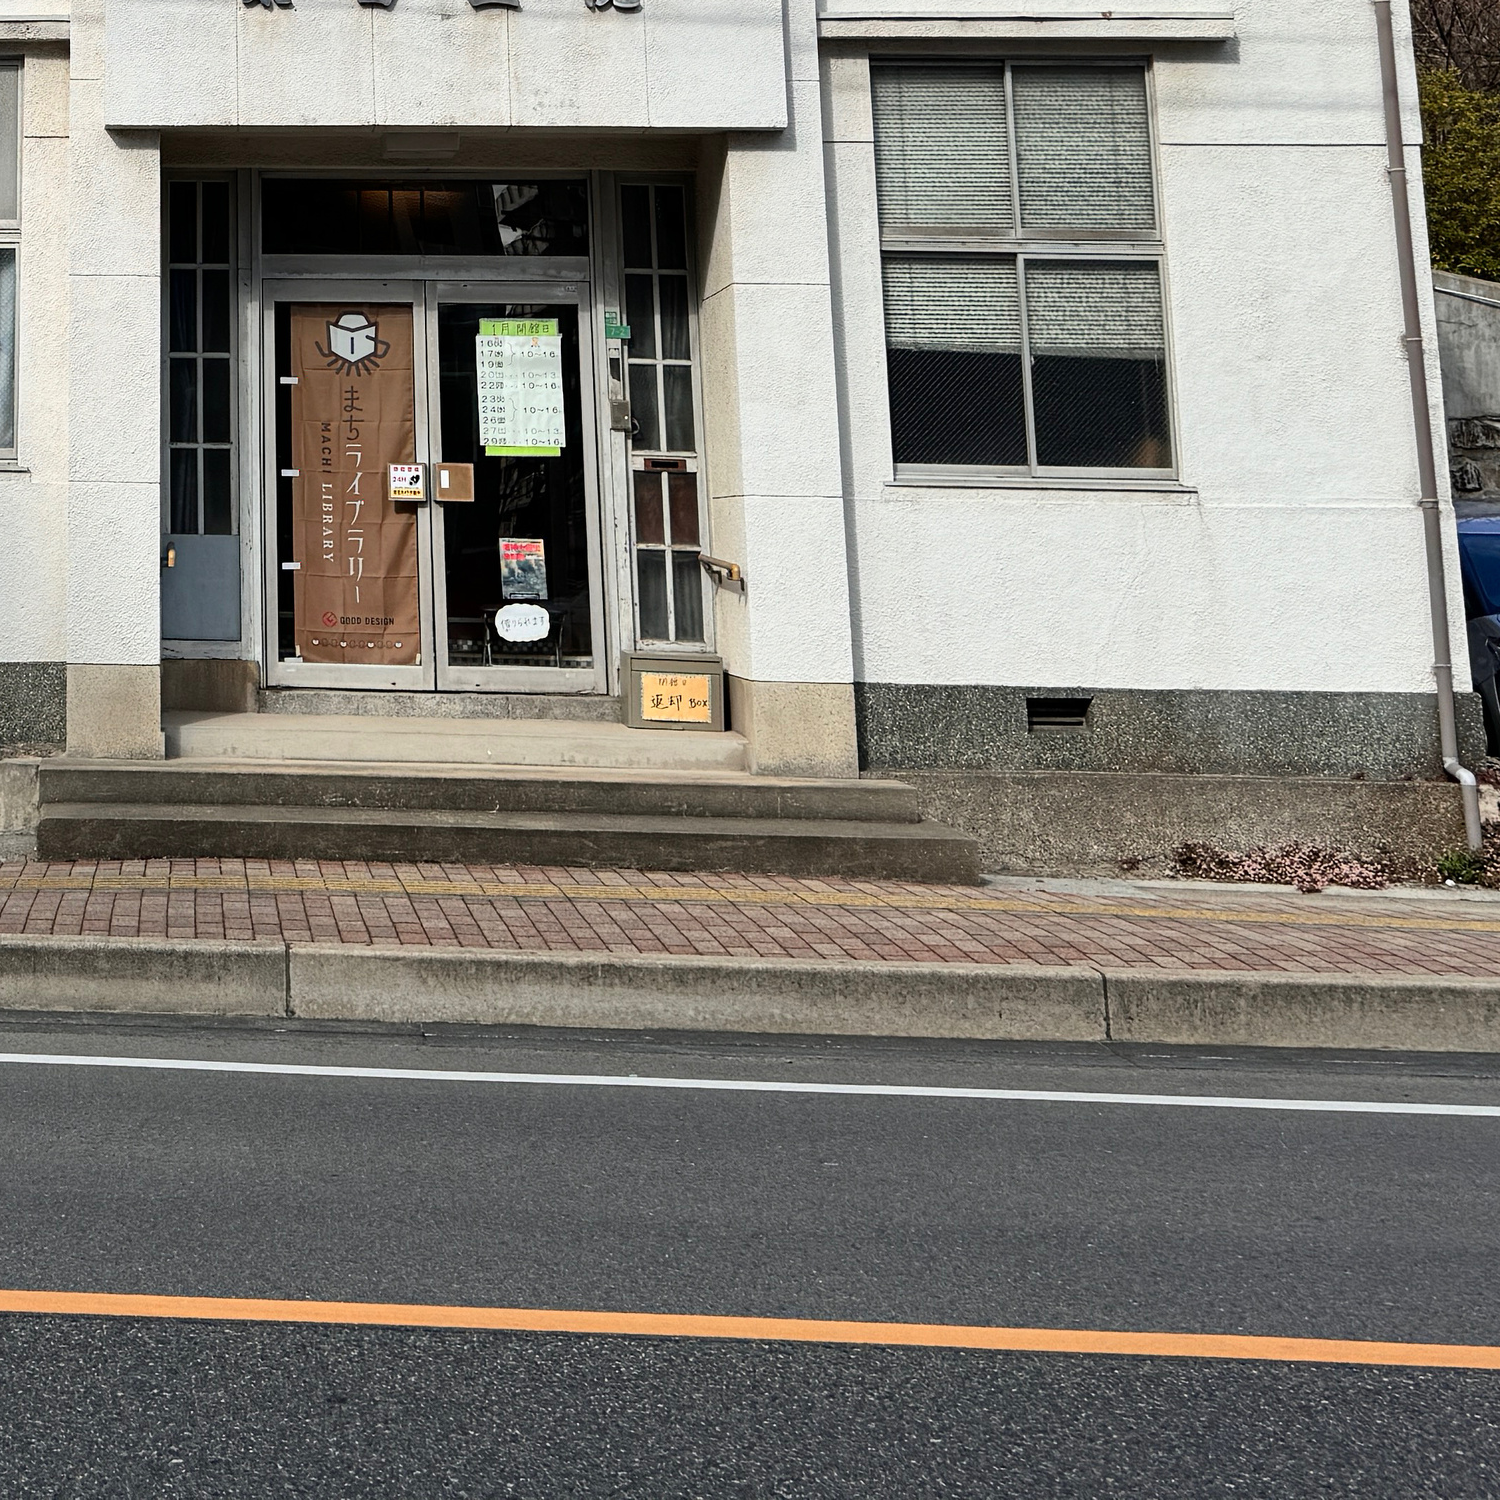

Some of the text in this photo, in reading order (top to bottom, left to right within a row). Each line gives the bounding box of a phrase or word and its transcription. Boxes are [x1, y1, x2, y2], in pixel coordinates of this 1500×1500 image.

[321, 421, 334, 563] MACHI LIBRARY
[342, 385, 365, 604] まちライブラリー
[340, 616, 395, 626] GOOD DESIGN
